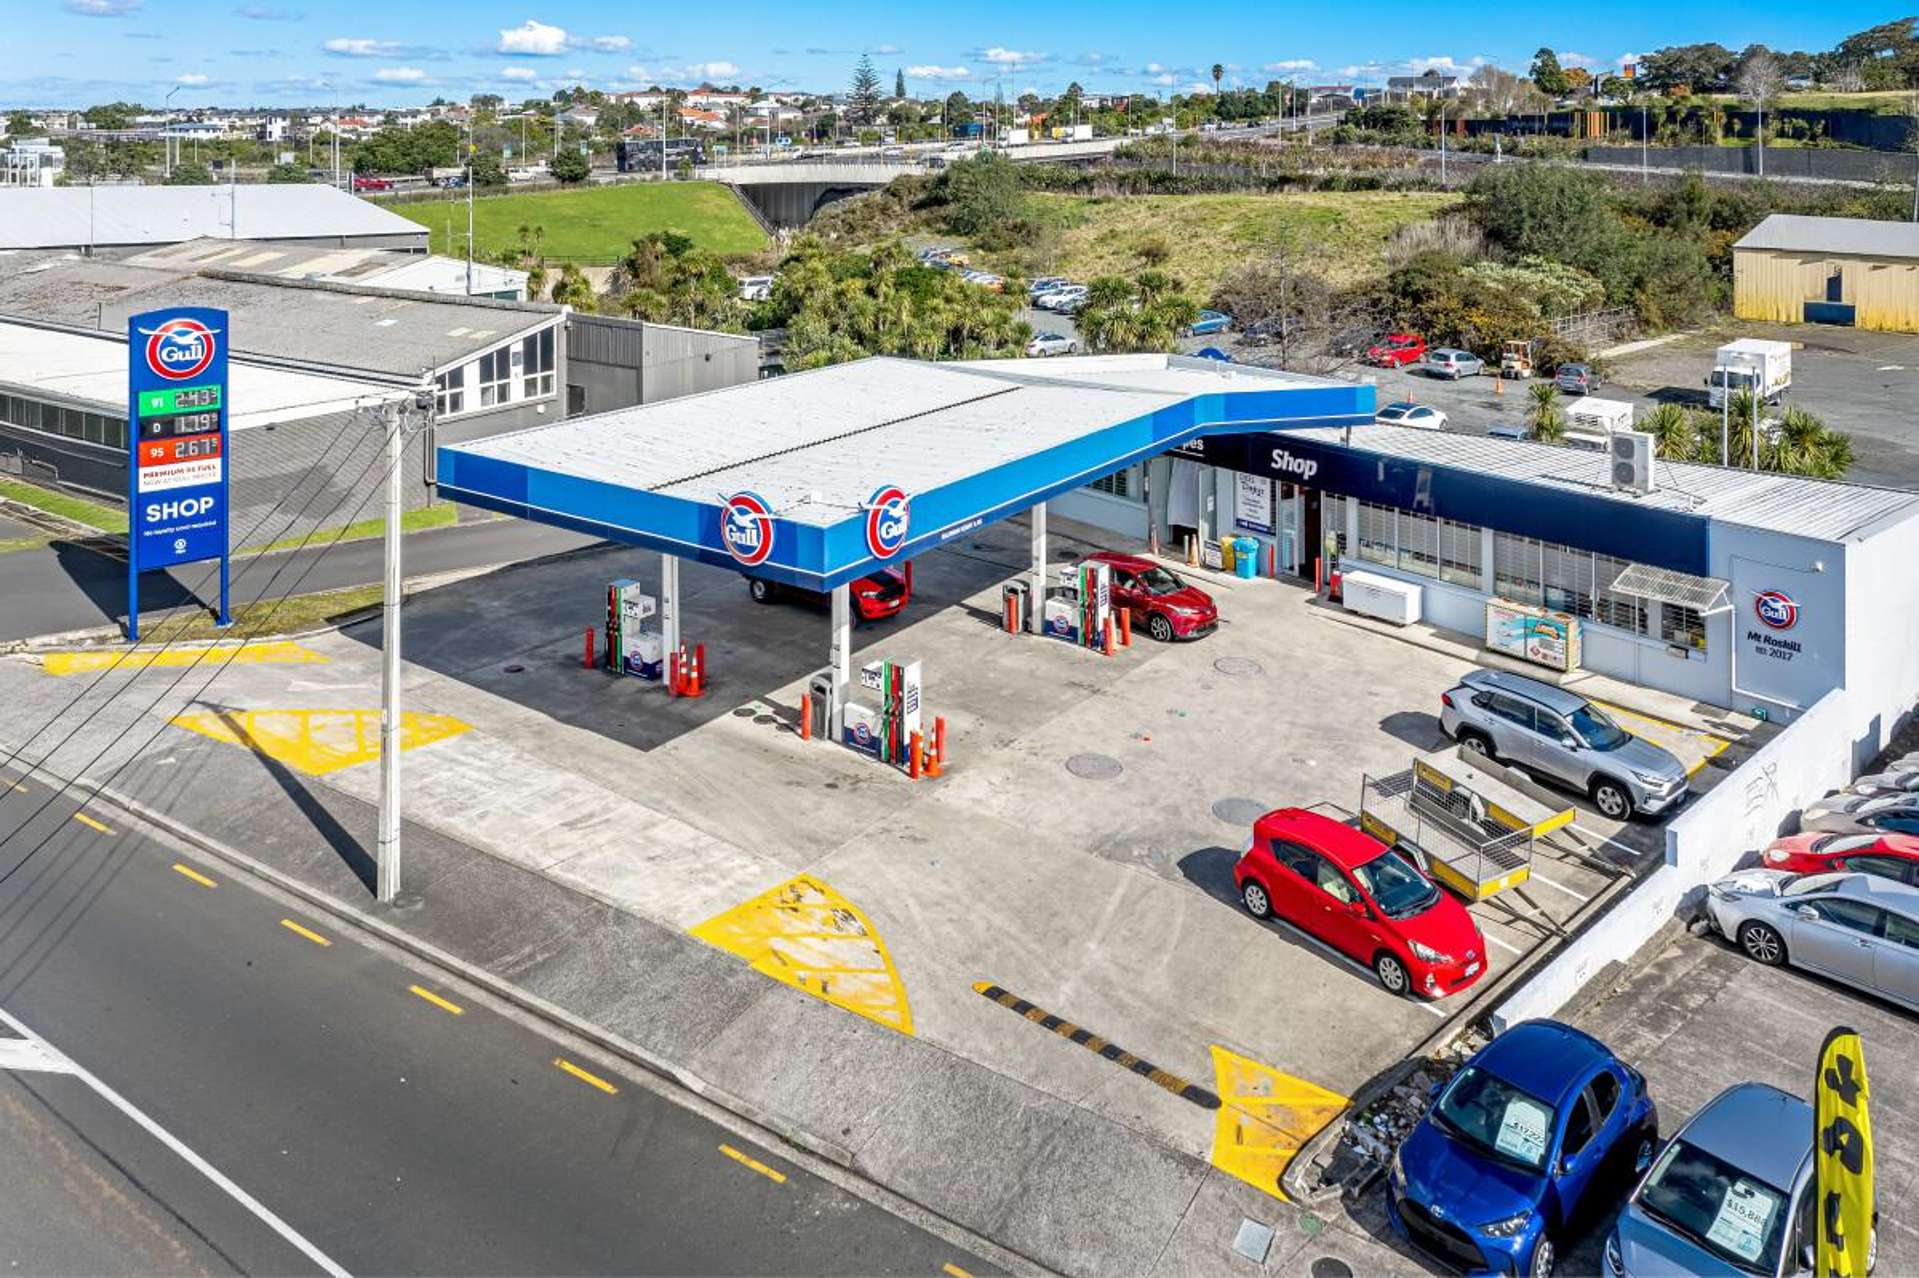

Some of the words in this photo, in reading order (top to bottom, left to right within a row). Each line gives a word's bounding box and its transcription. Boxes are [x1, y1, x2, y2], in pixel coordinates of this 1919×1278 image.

[161, 345, 202, 361] Gull
[151, 397, 164, 408] 91
[153, 422, 161, 432] D
[150, 447, 164, 458] 95
[1271, 449, 1318, 480] Shop
[146, 496, 214, 522] SHOP
[726, 524, 759, 547] Gull
[1761, 606, 1787, 620] Gull
[1747, 631, 1762, 643] Mt
[1763, 635, 1802, 653] Roskill
[1768, 646, 1794, 662] 2017
